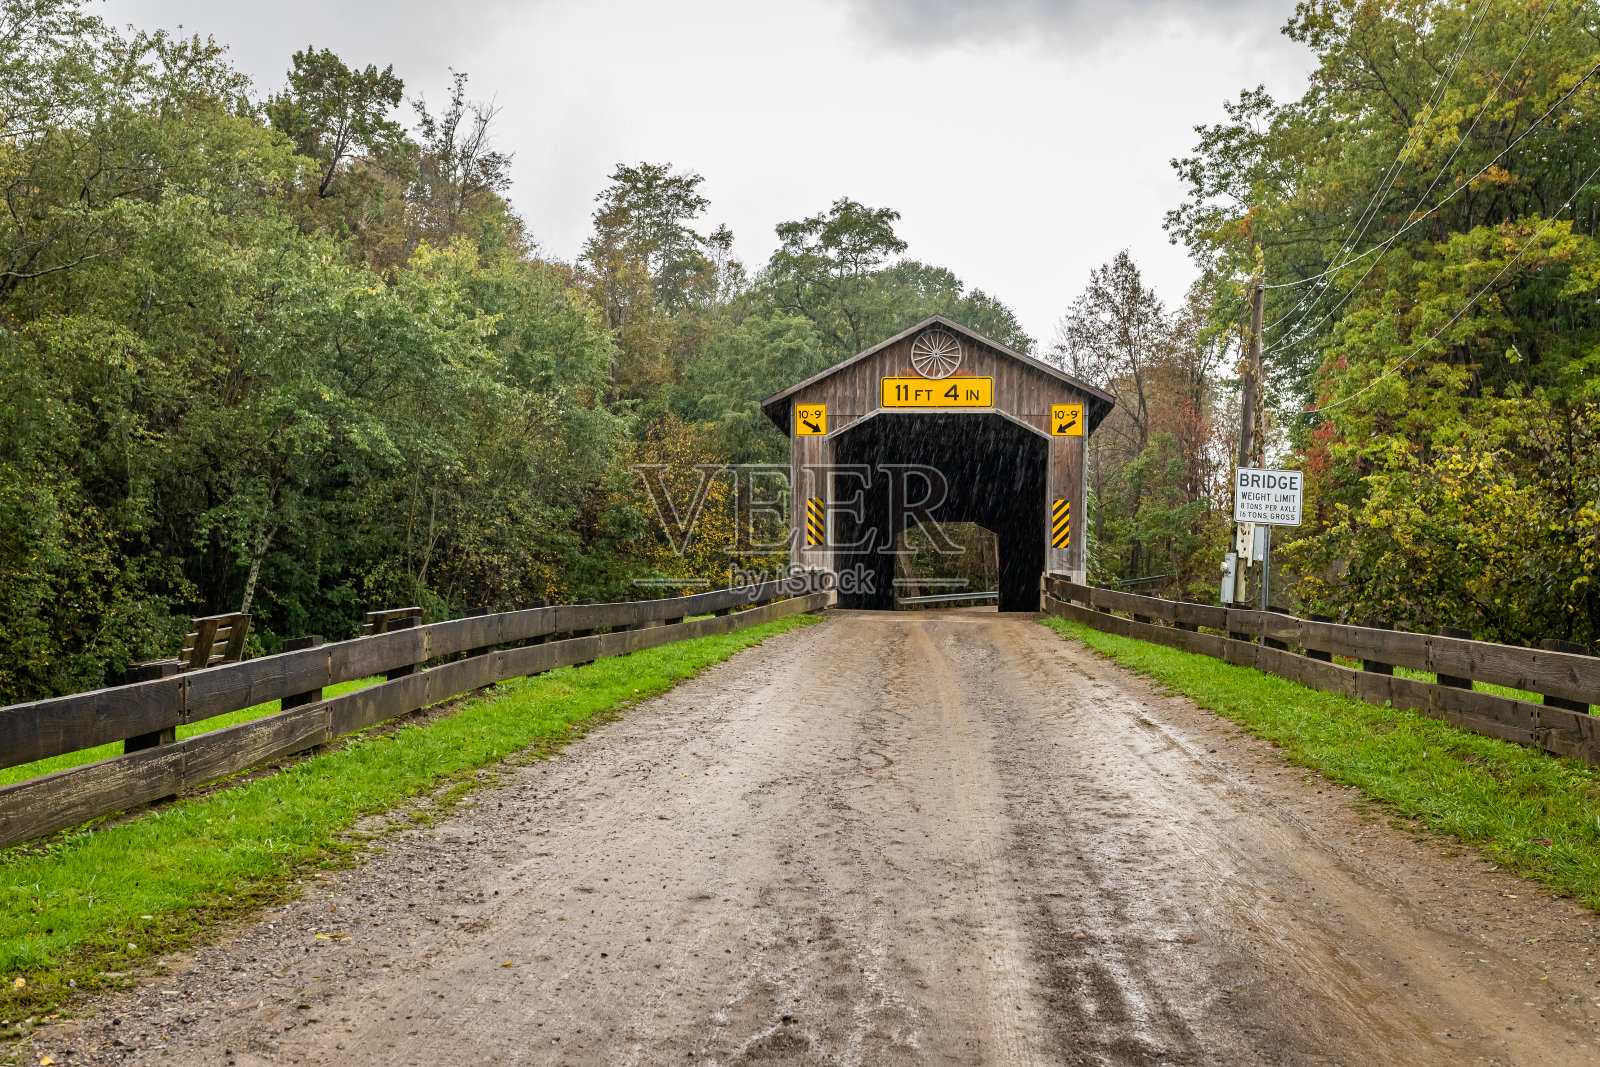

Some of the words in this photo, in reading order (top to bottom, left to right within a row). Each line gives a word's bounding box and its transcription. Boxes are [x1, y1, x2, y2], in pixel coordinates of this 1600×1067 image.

[895, 384, 909, 401] 11
[915, 389, 933, 401] FT
[944, 384, 960, 401] 4
[966, 389, 980, 401] IN
[1239, 473, 1299, 491] BRIDGE
[1241, 491, 1271, 502] WEIGHT
[1274, 494, 1296, 503] LIMIT
[1246, 502, 1263, 511] TONS
[1265, 504, 1278, 512] PER
[1280, 505, 1297, 513] AXLE
[1270, 513, 1296, 521] GROSS
